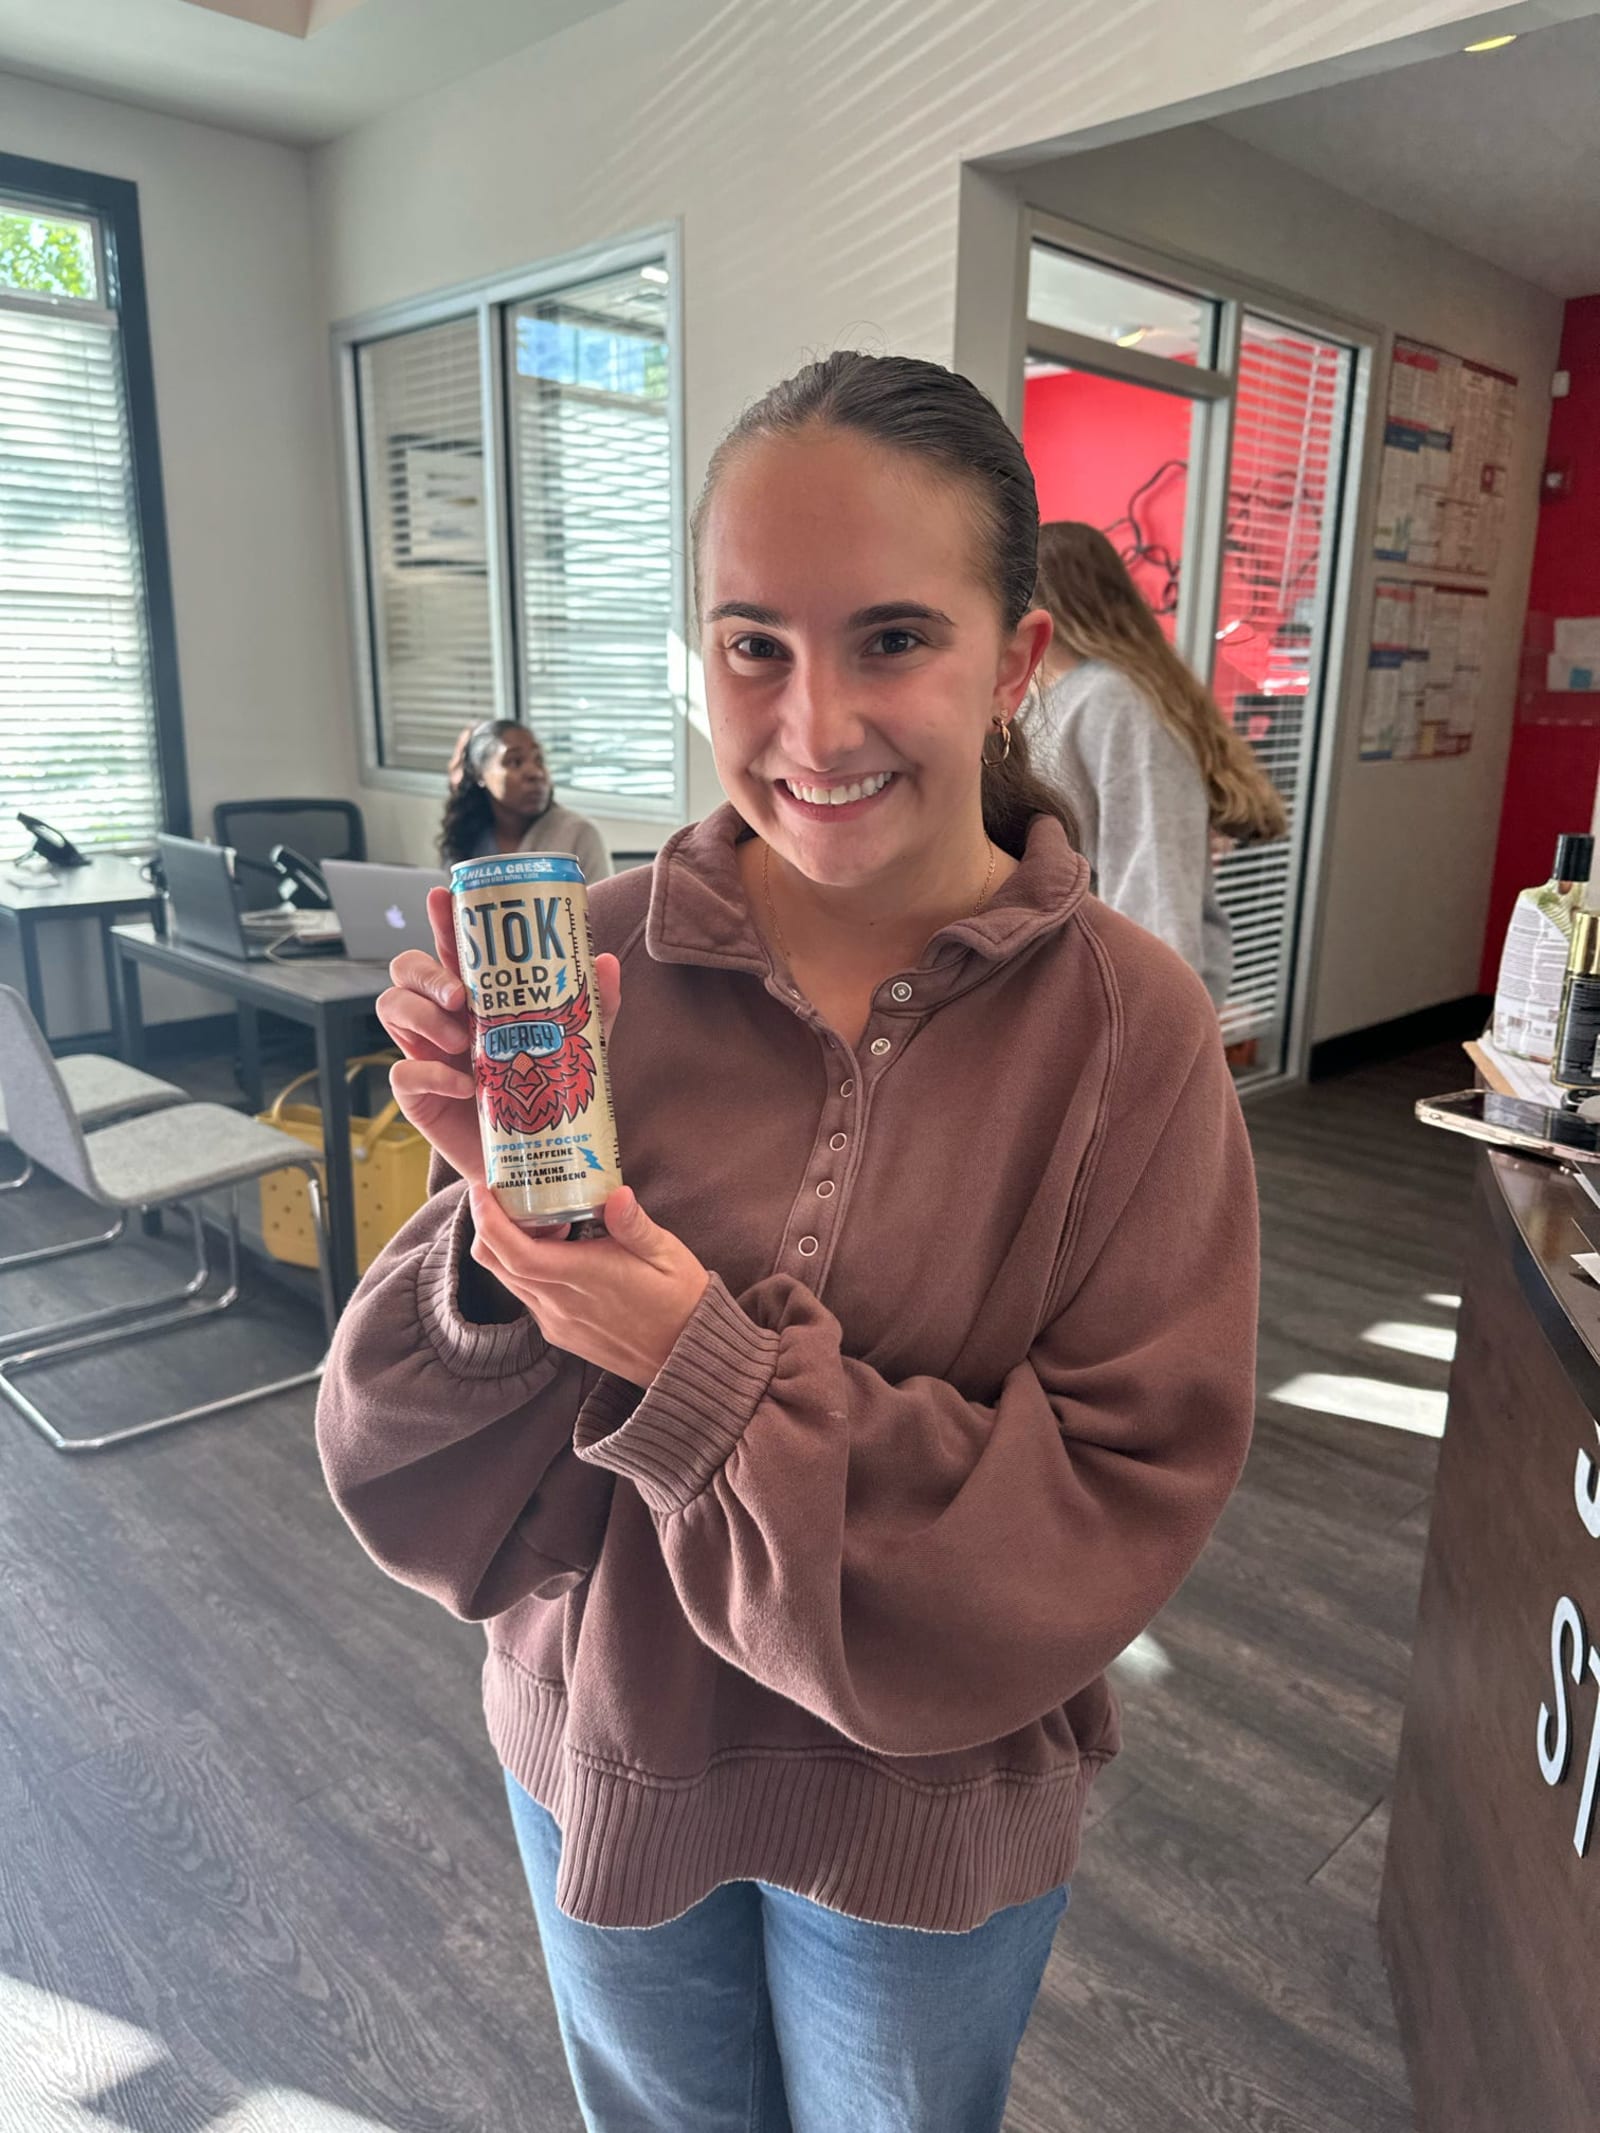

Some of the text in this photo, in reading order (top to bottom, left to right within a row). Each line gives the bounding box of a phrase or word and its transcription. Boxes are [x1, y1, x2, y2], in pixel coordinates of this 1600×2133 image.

[459, 865, 502, 881] ANILLA
[480, 966, 549, 990] COLD
[483, 986, 551, 1010] BREW
[489, 1023, 555, 1054] ENERGY
[491, 1140, 541, 1152] UPPORTS
[526, 1148, 573, 1160] CAFFEINE
[497, 1171, 587, 1188] GUARANA & GINSENG
[517, 1166, 564, 1178] VITAMINS
